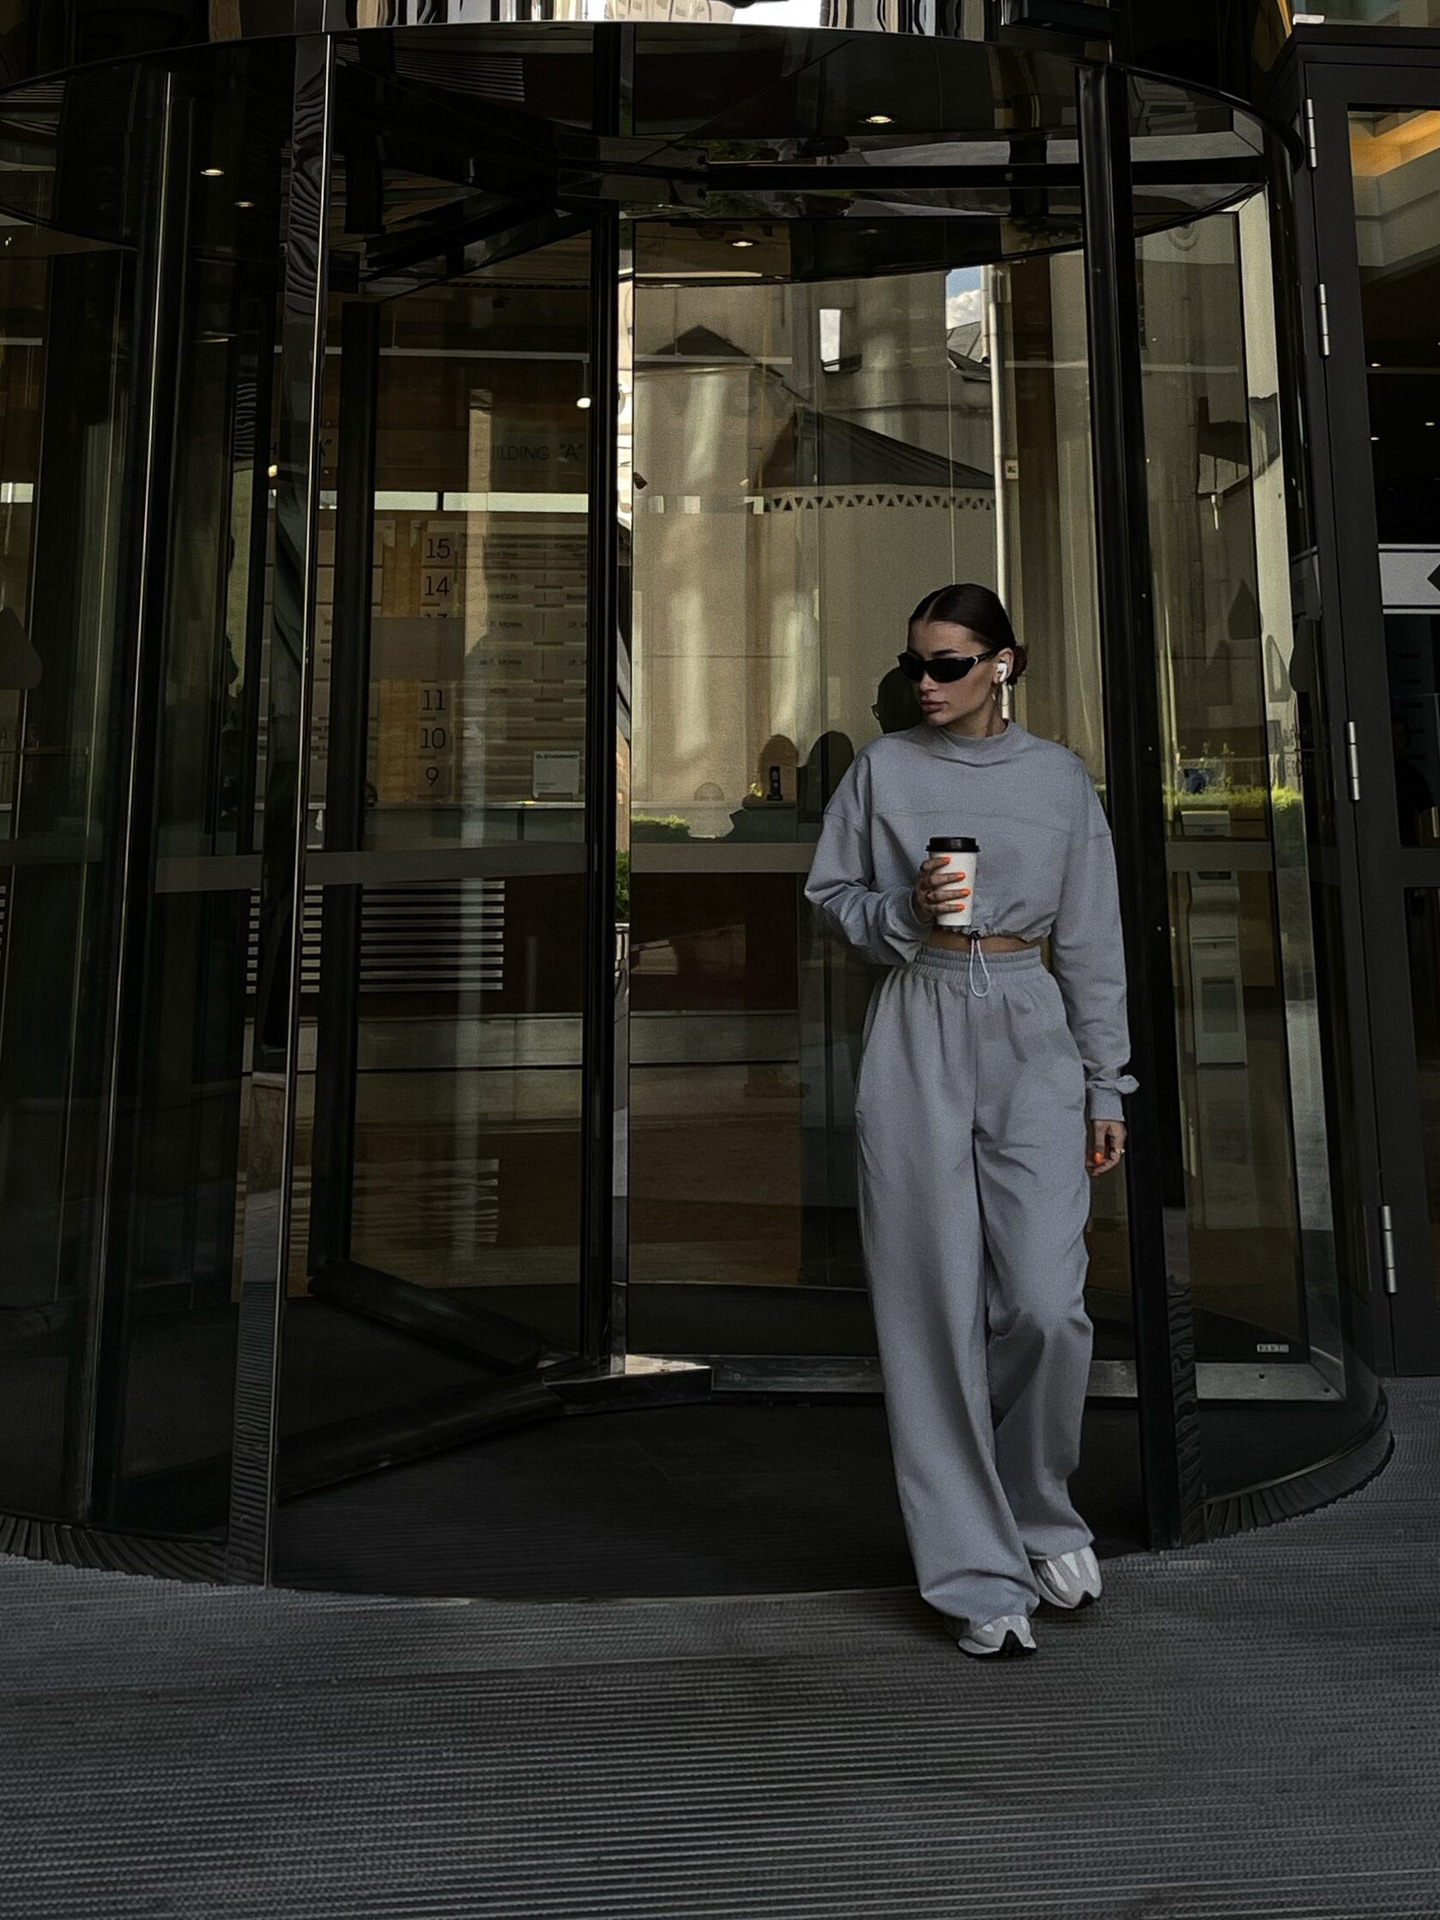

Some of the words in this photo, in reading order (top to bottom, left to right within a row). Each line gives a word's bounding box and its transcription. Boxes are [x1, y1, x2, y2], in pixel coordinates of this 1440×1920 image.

[425, 538, 451, 559] 15
[425, 575, 450, 596] 14
[421, 689, 446, 711] 11
[420, 727, 446, 749] 10
[425, 766, 440, 788] 9
